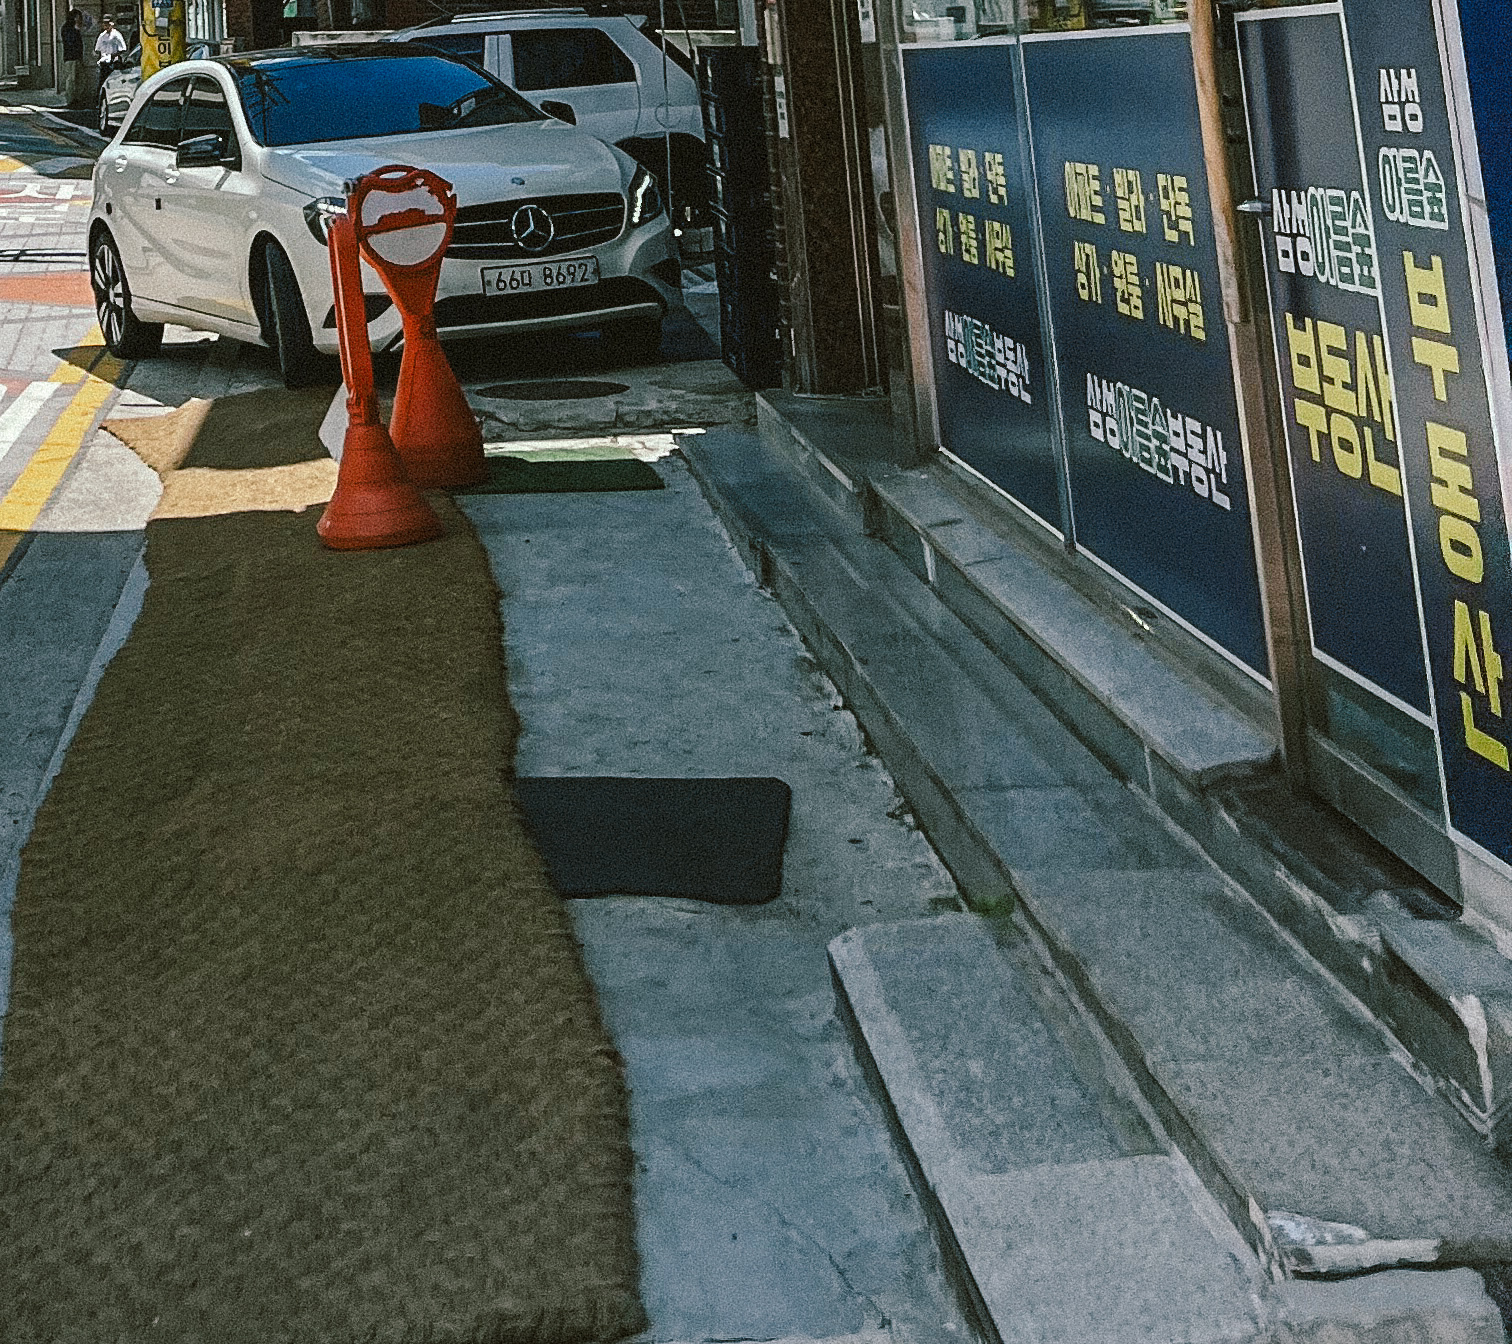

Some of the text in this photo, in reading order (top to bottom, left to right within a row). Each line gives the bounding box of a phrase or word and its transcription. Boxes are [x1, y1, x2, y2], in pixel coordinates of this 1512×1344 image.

[1379, 68, 1424, 133] 삼성
[1065, 161, 1195, 247] 아파트 빌라 단독
[543, 263, 589, 286] 8692
[1074, 240, 1206, 341] 상가 원룸 사무실
[1285, 312, 1402, 497] 부동산
[1402, 251, 1509, 771] 부동산
